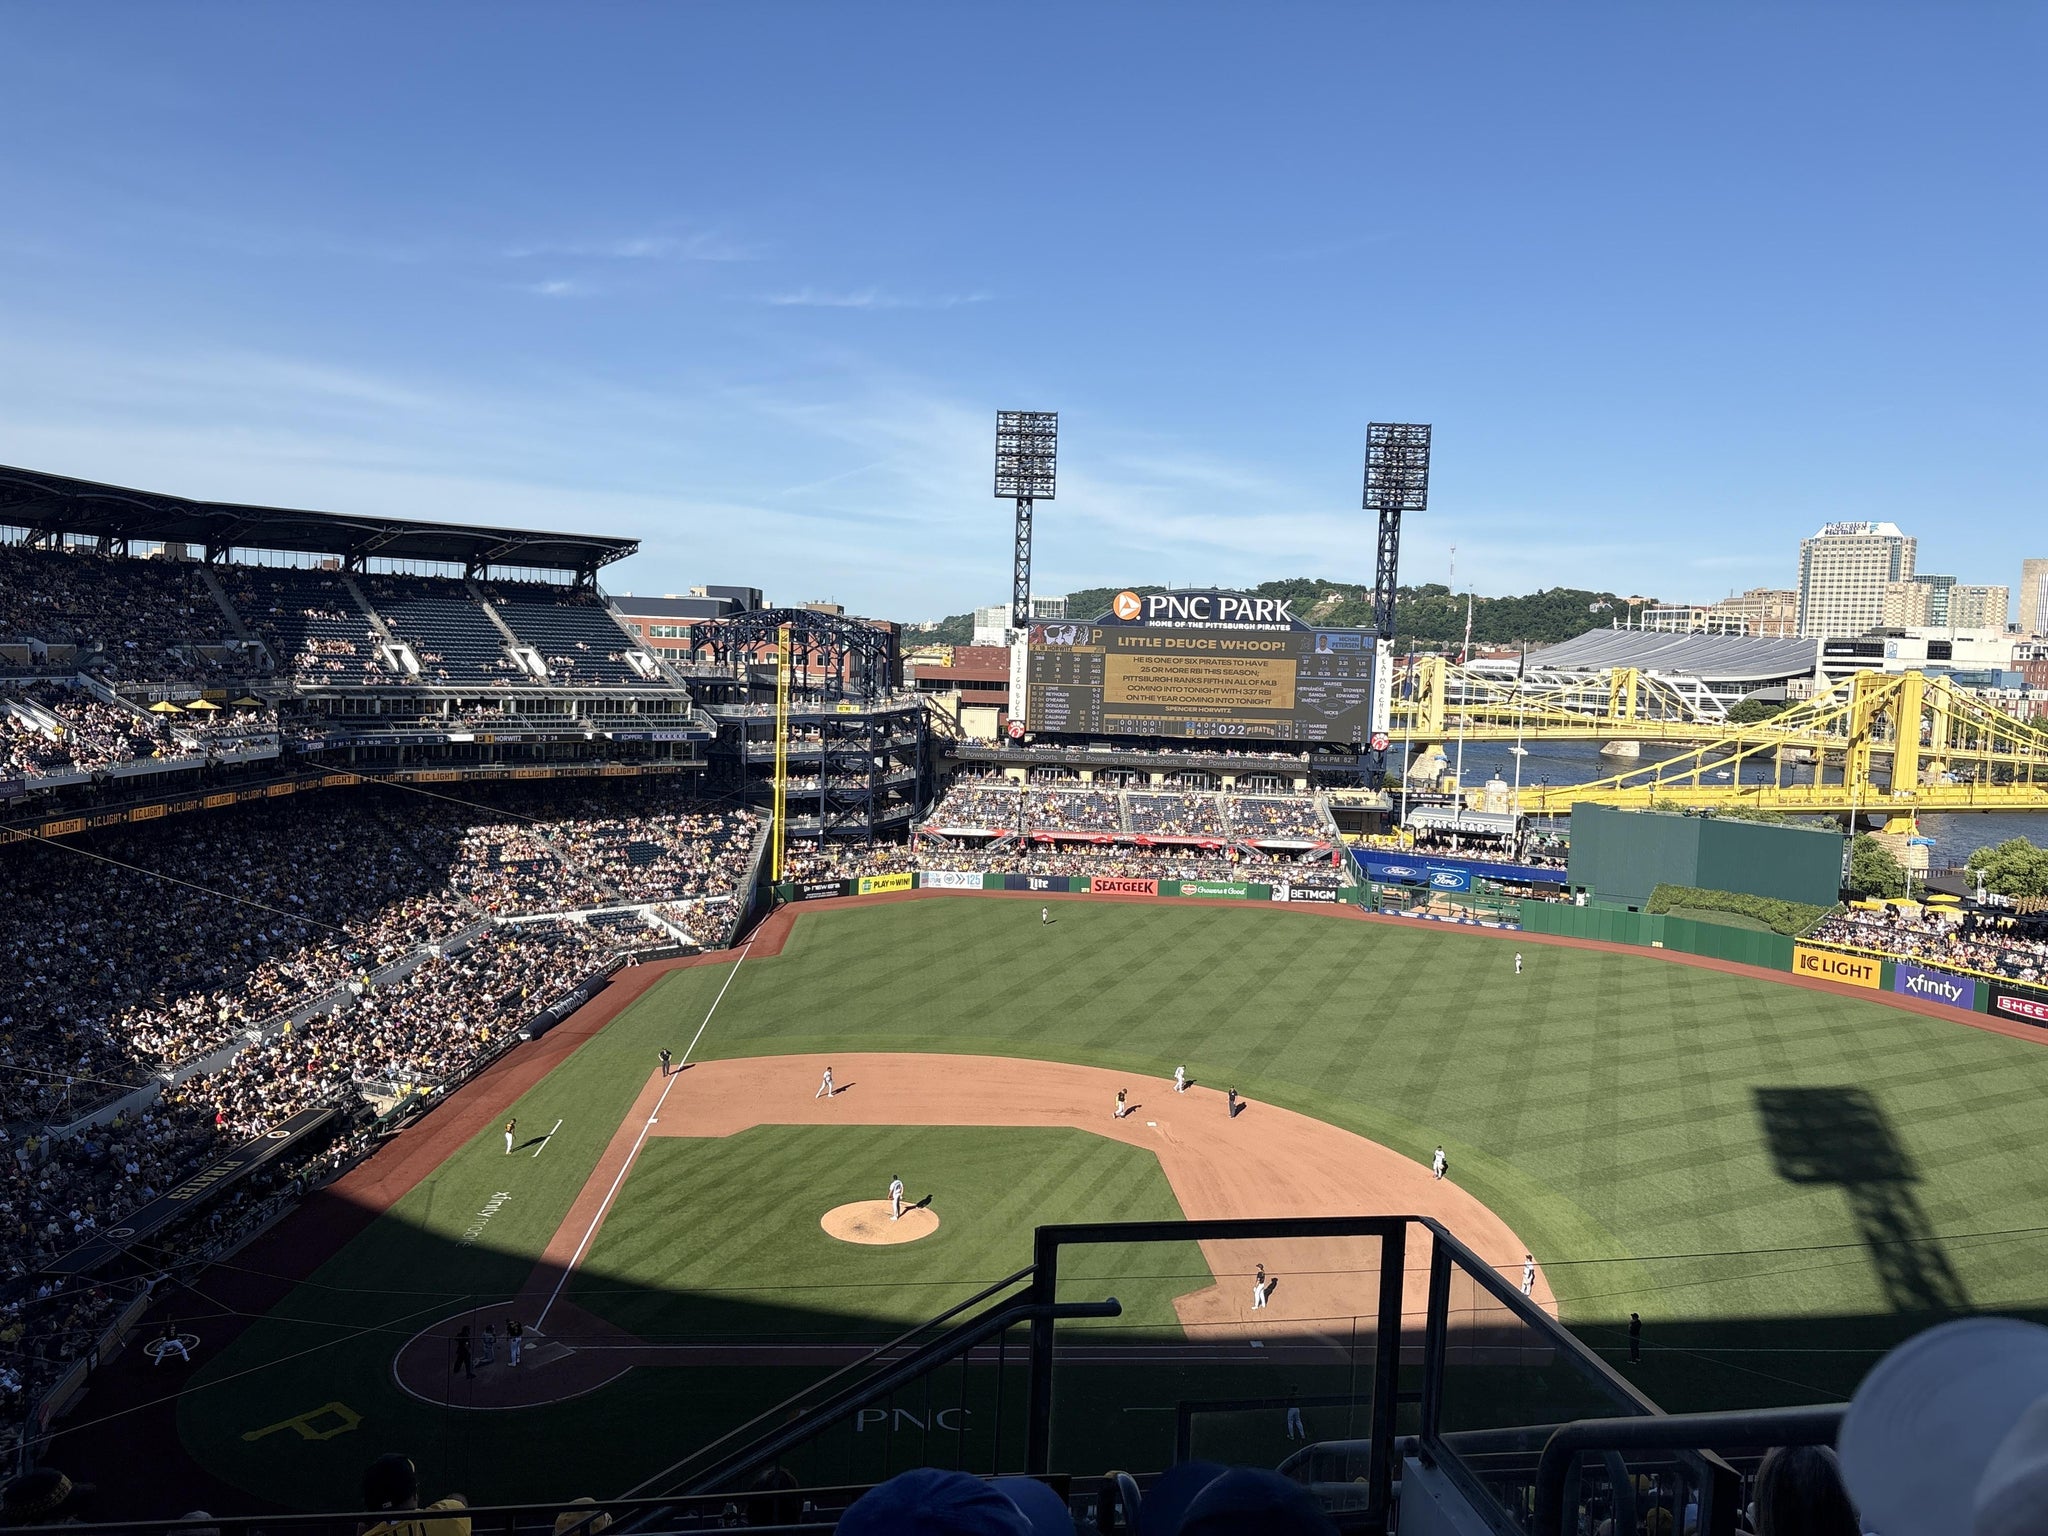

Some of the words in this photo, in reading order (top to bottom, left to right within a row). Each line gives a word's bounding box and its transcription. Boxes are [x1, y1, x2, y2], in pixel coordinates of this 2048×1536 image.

[1147, 595, 1210, 620] PNC
[1217, 597, 1293, 622] PARK
[1188, 621, 1204, 629] THE
[1205, 622, 1256, 630] PITTSBURGH
[1118, 636, 1162, 648] LITTLE
[1164, 638, 1217, 650] DEUCE
[1220, 640, 1286, 652] WHOOP!
[1199, 658, 1232, 666] PIRATES
[1122, 675, 1173, 683] PITTSBURGH
[147, 692, 162, 702] CITY
[162, 691, 171, 701] OF
[172, 690, 202, 701] CHAMPIONS
[1246, 725, 1275, 736] PIRATES
[965, 751, 998, 760] Powering
[999, 752, 1034, 761] Pittsburgh
[1086, 755, 1118, 765] Powering
[1119, 756, 1156, 766] Pittsburgh
[1208, 760, 1241, 769] Powering
[1242, 761, 1278, 770] Pittsburgh
[381, 773, 404, 782] LIGHT
[432, 772, 454, 781] LIGHT
[481, 771, 502, 780] LIGHT
[528, 769, 549, 778] LIGHT
[574, 768, 593, 776] LIGHT
[249, 789, 262, 800] LIGHT
[277, 784, 291, 795] LIGHT
[217, 794, 232, 804] LIGHT
[181, 800, 198, 811] LIGHT
[144, 806, 162, 817] LIGHT
[103, 812, 122, 826] LIGHT
[1427, 819, 1448, 829] FAT
[59, 819, 79, 834] LIGHT
[9, 828, 32, 843] LIGHT
[1387, 866, 1411, 876] Ford
[873, 880, 889, 889] PLAY
[895, 878, 911, 887] WIN!
[966, 874, 981, 886] 125
[1029, 877, 1049, 891] Lite
[1434, 873, 1457, 885] Ford
[1094, 879, 1154, 894] SEATGEEK
[1197, 885, 1224, 895] Growers
[1227, 887, 1246, 896] Good
[1290, 889, 1336, 900] BETMGM
[1800, 953, 1819, 972] IC
[1822, 958, 1873, 980] LIGHT
[1905, 972, 1964, 1002] xfinity
[167, 1160, 245, 1200] PIRATES
[476, 1191, 512, 1218] xfinity
[456, 1218, 490, 1249] mobile
[856, 1408, 973, 1432] PNC
